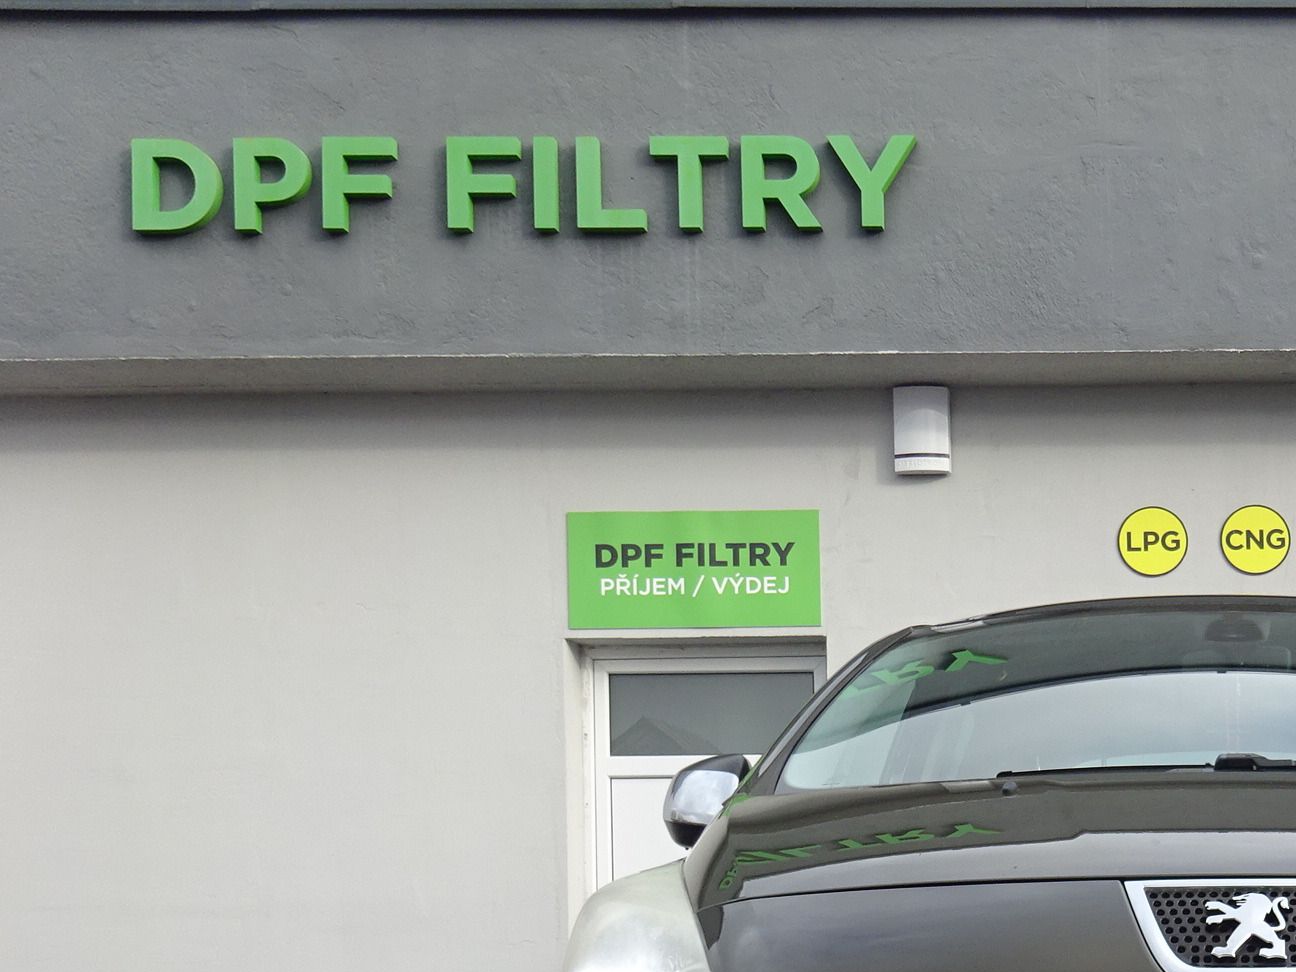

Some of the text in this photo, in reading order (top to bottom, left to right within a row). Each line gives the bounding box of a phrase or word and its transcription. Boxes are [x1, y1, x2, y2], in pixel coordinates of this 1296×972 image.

[130, 134, 917, 236] DPF FILTRY
[1126, 530, 1181, 552] LPG
[1225, 529, 1286, 550] CNG
[595, 541, 795, 568] DPF FILTRY
[600, 572, 790, 598] PŘÍJEM / VÝDEJ
